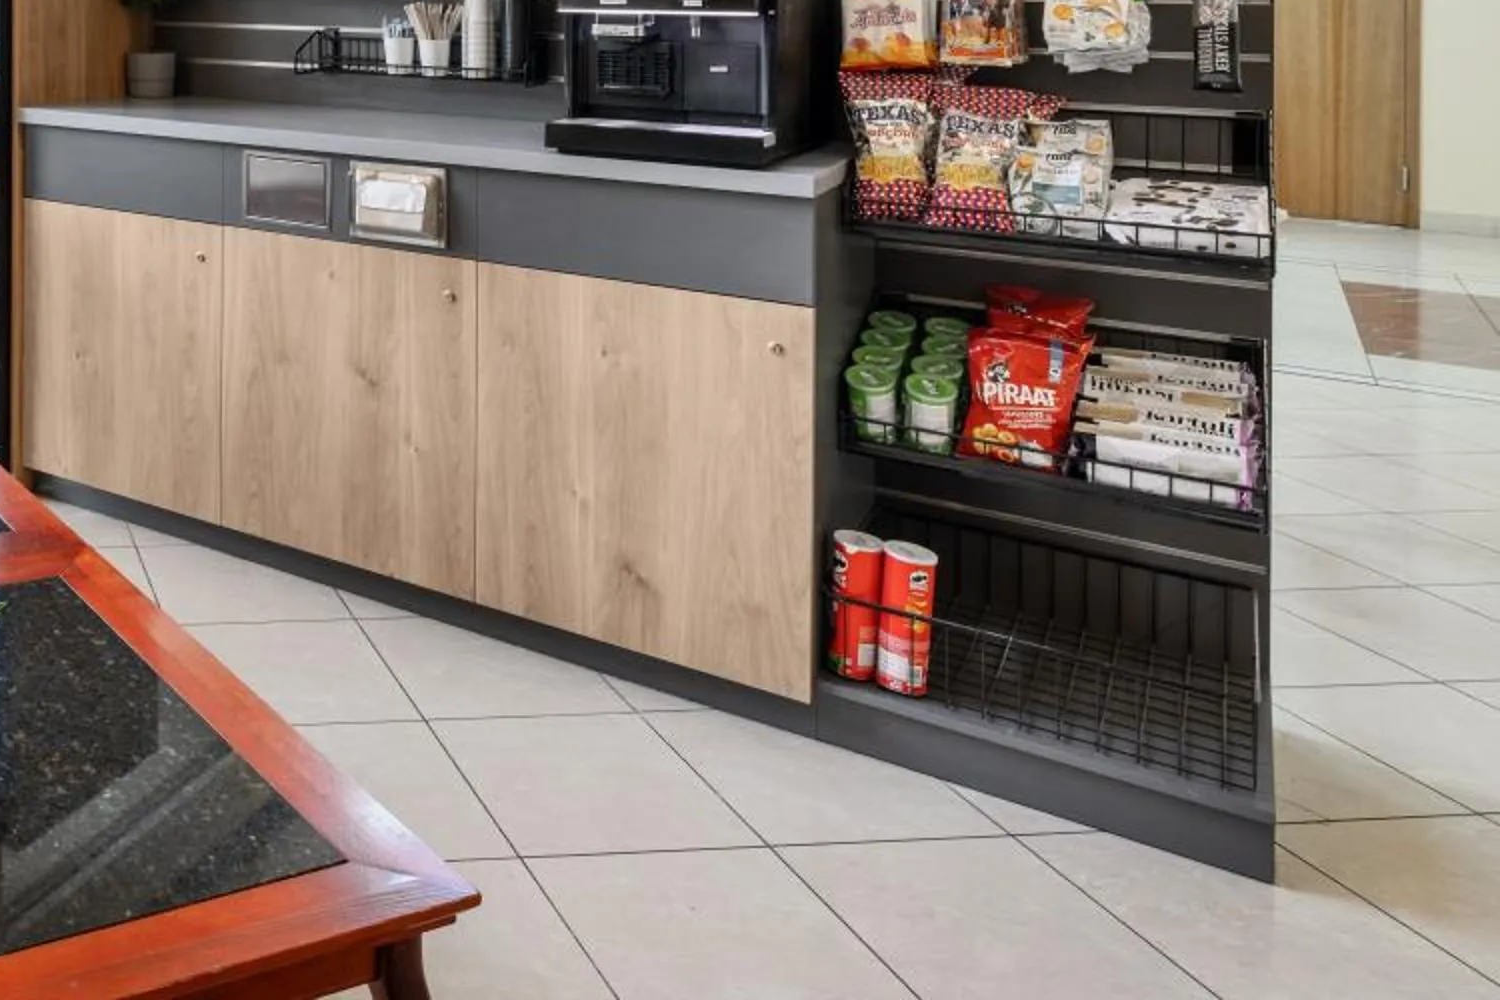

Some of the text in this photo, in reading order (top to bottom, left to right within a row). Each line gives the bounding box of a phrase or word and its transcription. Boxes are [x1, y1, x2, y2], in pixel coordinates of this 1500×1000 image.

[853, 105, 921, 126] TEXAS
[946, 115, 1015, 139] TEXAS
[983, 380, 1057, 407] PIRAAT
